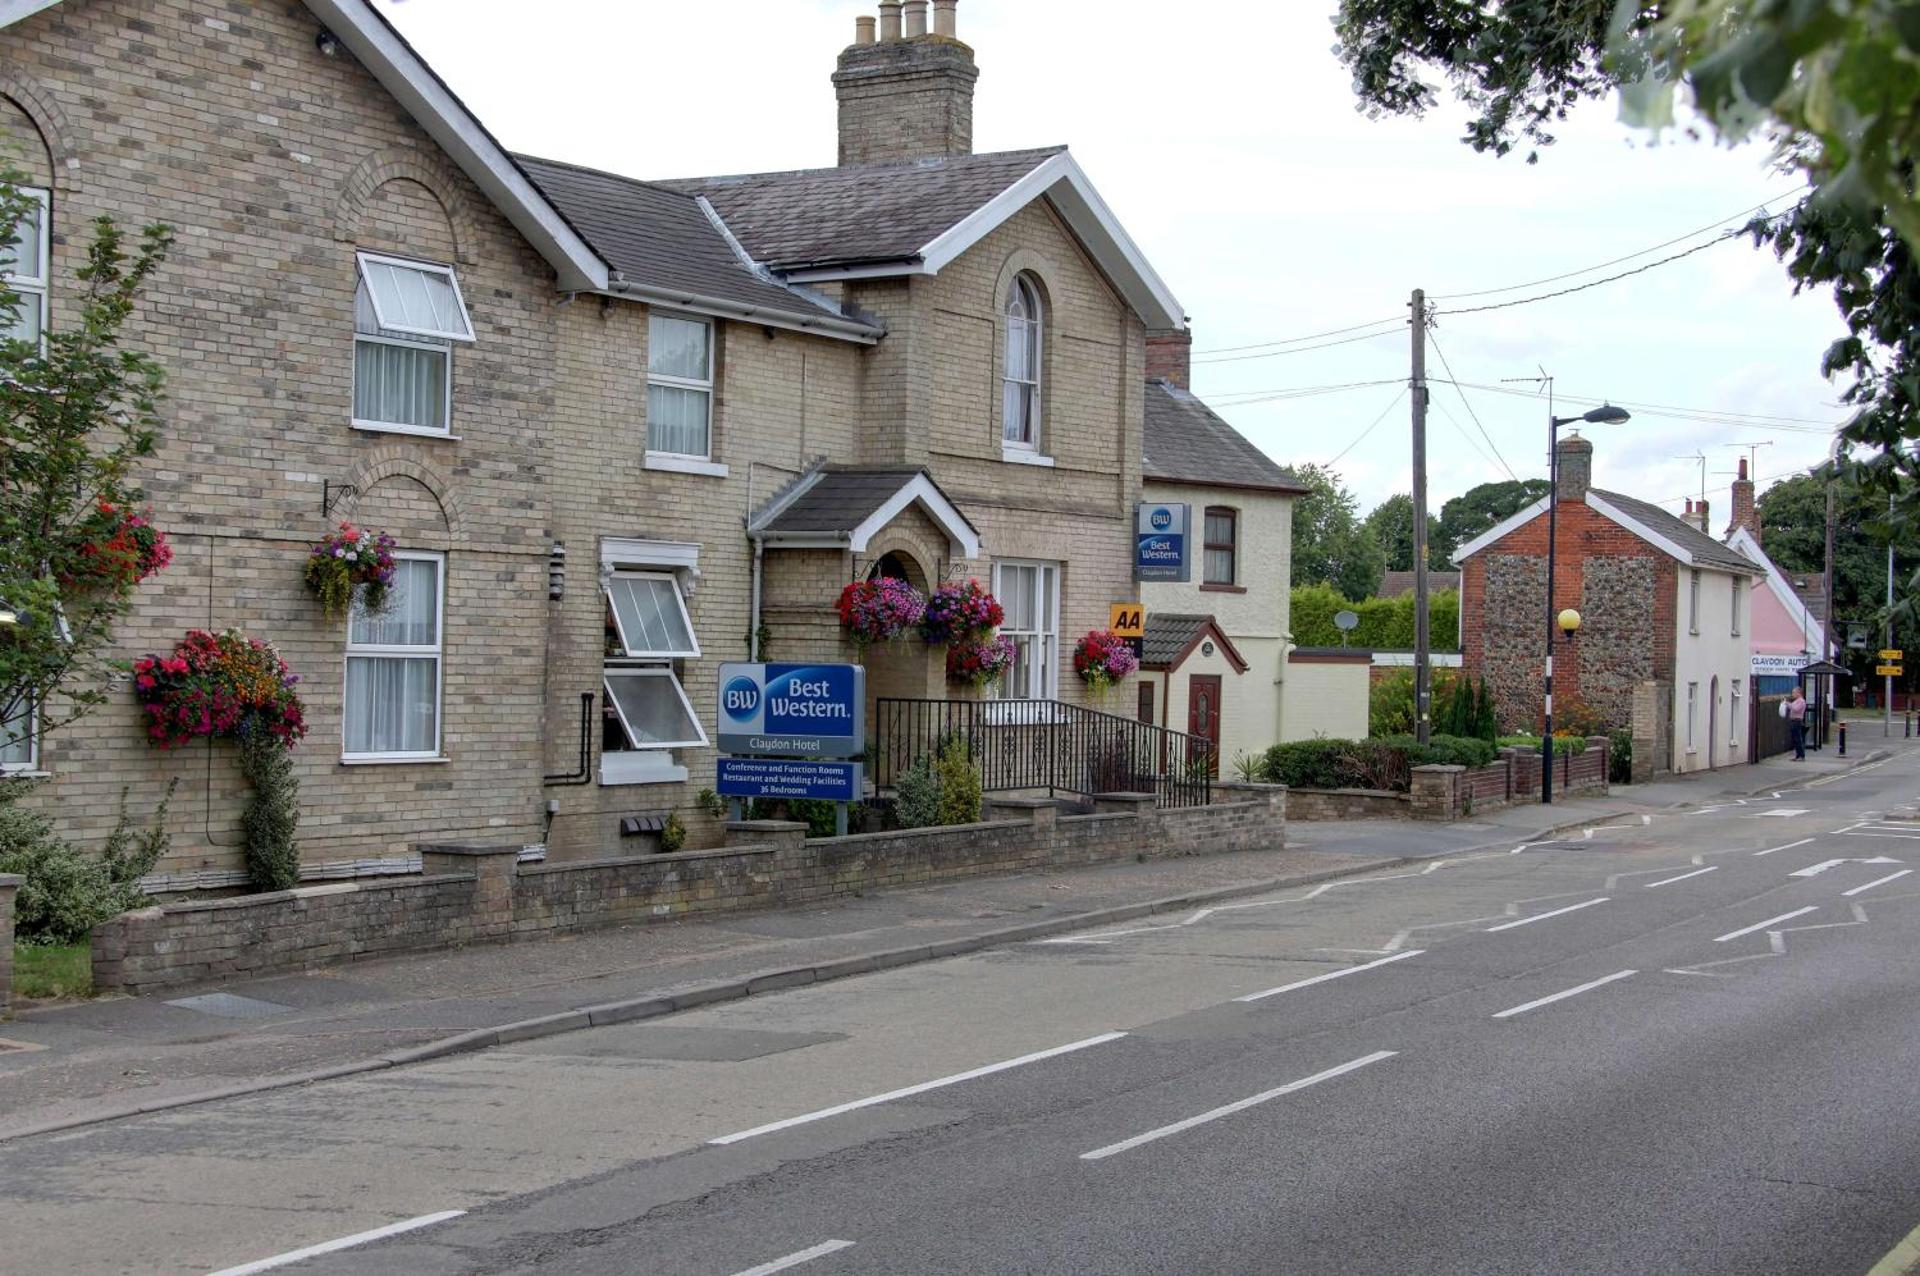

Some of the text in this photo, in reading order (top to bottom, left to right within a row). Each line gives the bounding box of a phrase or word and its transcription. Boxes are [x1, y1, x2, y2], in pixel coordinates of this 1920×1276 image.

[1151, 541, 1170, 550] Best
[1114, 611, 1140, 629] AA
[1752, 657, 1785, 665] CLAYDON
[789, 678, 830, 698] Best
[727, 690, 757, 709] BW
[749, 737, 820, 751] Claydon Hotel
[726, 762, 844, 775] Conference and Function Rooms
[722, 773, 846, 786] Restaurant and Wedding Facilities
[760, 785, 807, 795] 36 Bedrooms
